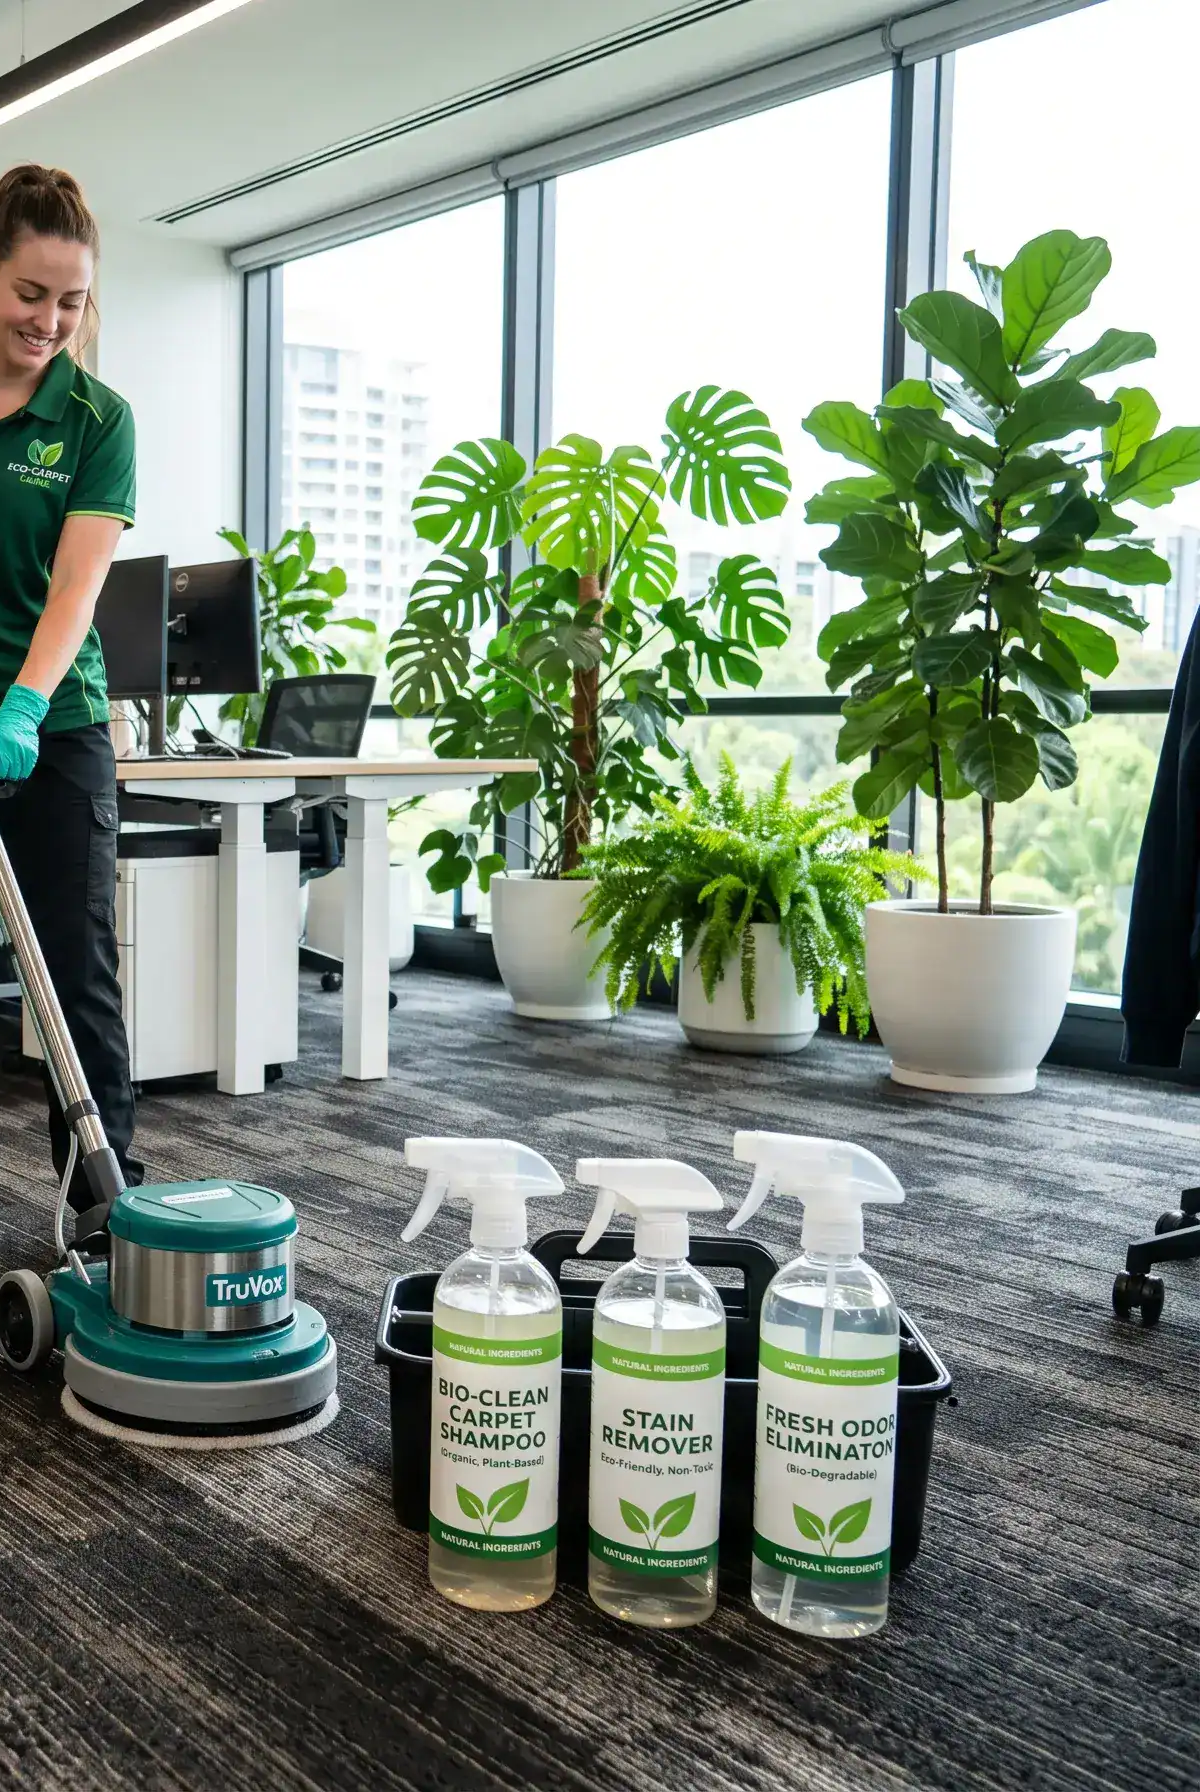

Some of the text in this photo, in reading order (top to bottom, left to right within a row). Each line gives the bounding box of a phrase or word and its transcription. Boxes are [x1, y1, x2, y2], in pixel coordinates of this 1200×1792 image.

[7, 462, 71, 484] ECO-CARPET
[212, 1274, 283, 1301] TruVox
[449, 1342, 543, 1358] NATURAL INGREDIENTS
[612, 1357, 709, 1374] NATURAL INGREDIENTS
[784, 1361, 886, 1379] NATURAL INGREDIENTS
[438, 1377, 549, 1408] BIO-CLEAN
[449, 1405, 536, 1429] CARPET
[622, 1408, 694, 1432] STAIN
[766, 1403, 895, 1438] FRESH ODOR
[440, 1421, 546, 1451] SHAMPOO
[602, 1424, 713, 1455] REMOVER
[786, 1463, 878, 1481] (Bio-Degradable)
[441, 1531, 480, 1550] NATURAL
[603, 1546, 708, 1568] NATURAL INGREDIENTS
[775, 1552, 884, 1575] NATURAL INGREDIENTS
